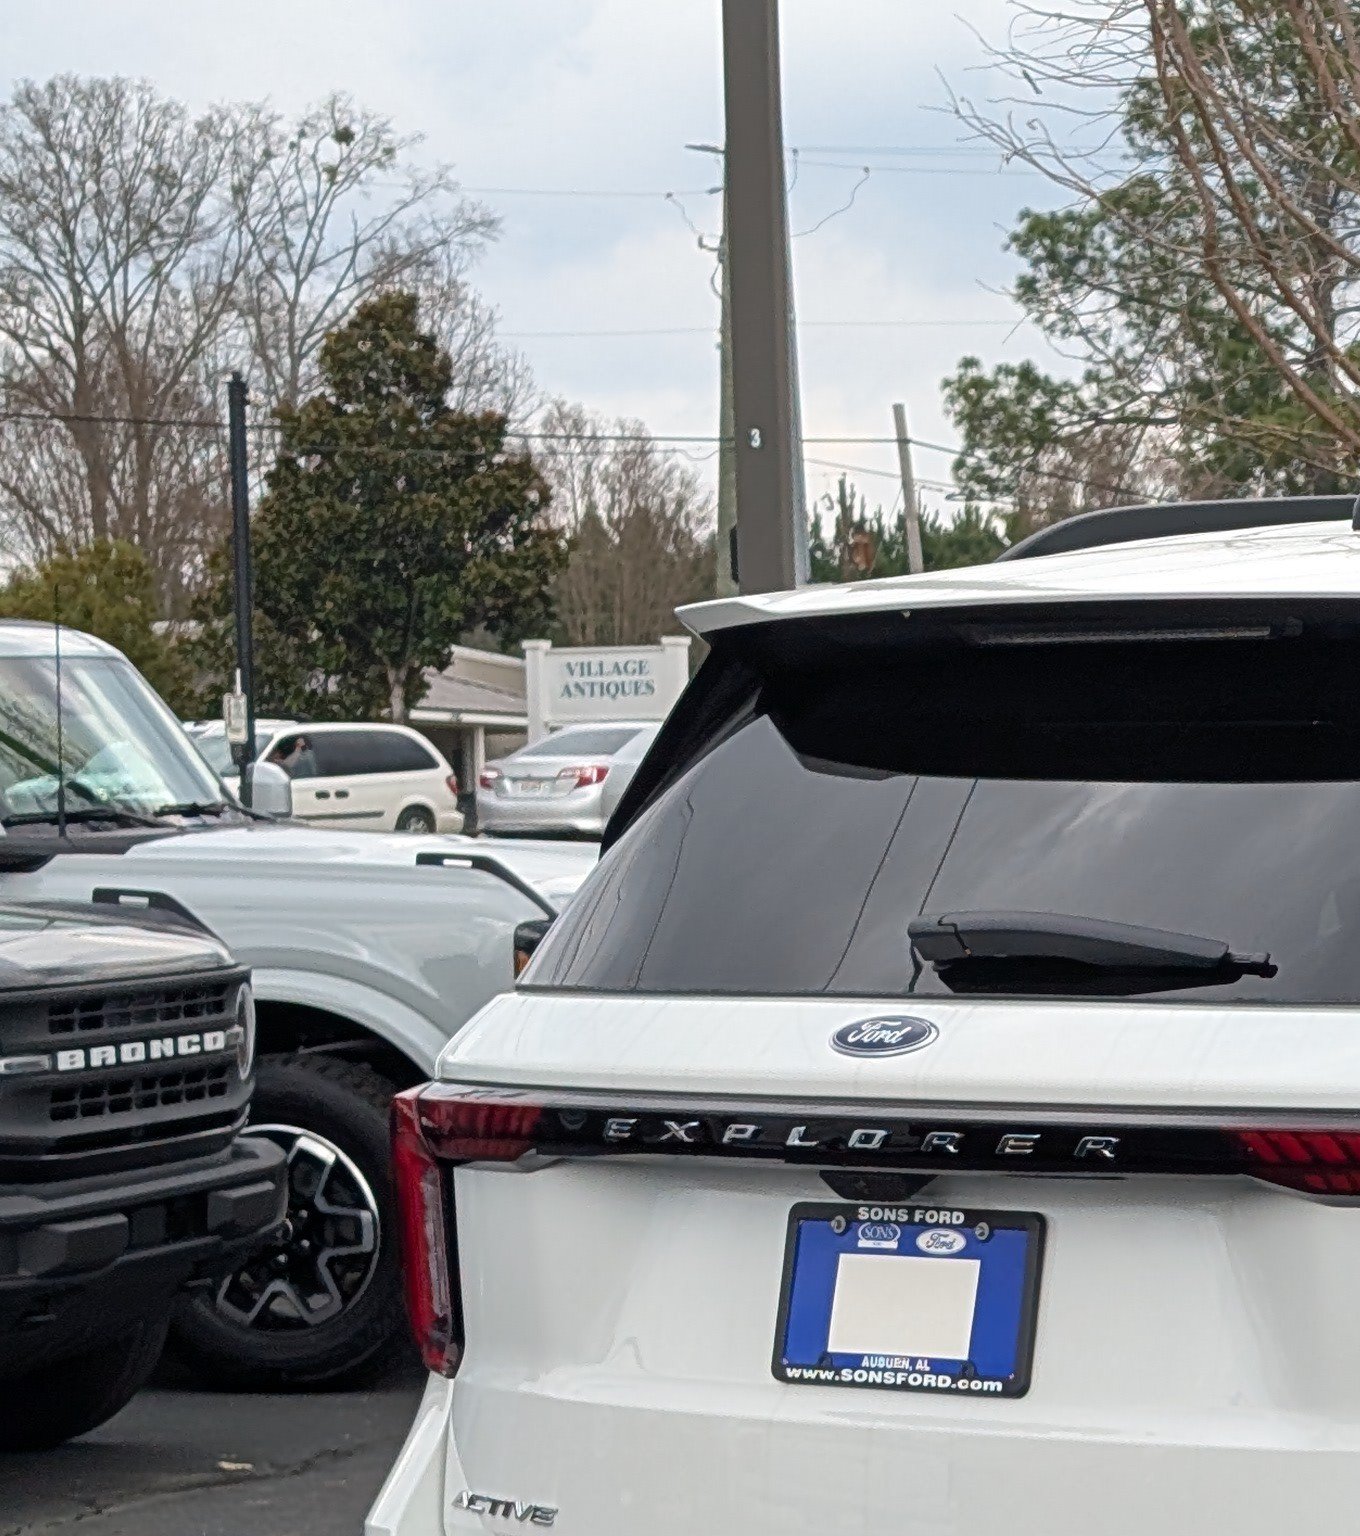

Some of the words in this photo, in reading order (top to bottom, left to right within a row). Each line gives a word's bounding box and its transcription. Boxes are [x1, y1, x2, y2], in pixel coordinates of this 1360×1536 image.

[564, 658, 651, 678] VILLAGE
[559, 679, 656, 700] ANTIQUES
[846, 1019, 906, 1047] Ford
[56, 1030, 226, 1073] BRONCO
[602, 1115, 1123, 1162] EXPLORER
[857, 1206, 909, 1223] SONS
[913, 1209, 965, 1226] FORD
[785, 1366, 1003, 1393] www.SONSFORD.com
